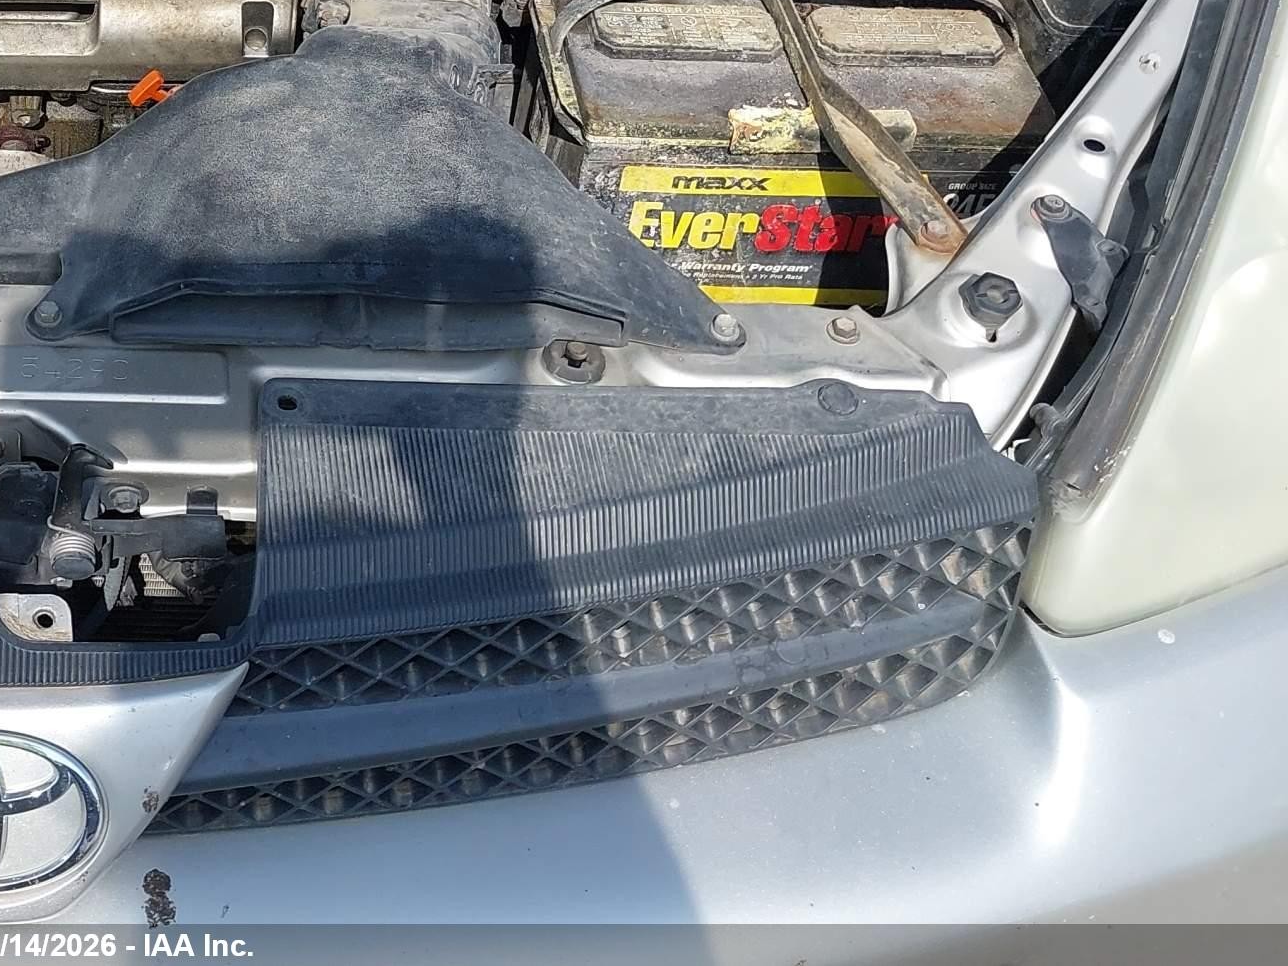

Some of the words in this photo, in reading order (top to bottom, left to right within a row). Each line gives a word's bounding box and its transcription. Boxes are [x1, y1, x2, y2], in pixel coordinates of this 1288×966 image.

[633, 6, 682, 14] DANGER
[671, 175, 773, 191] maxx
[681, 262, 745, 273] Warranty
